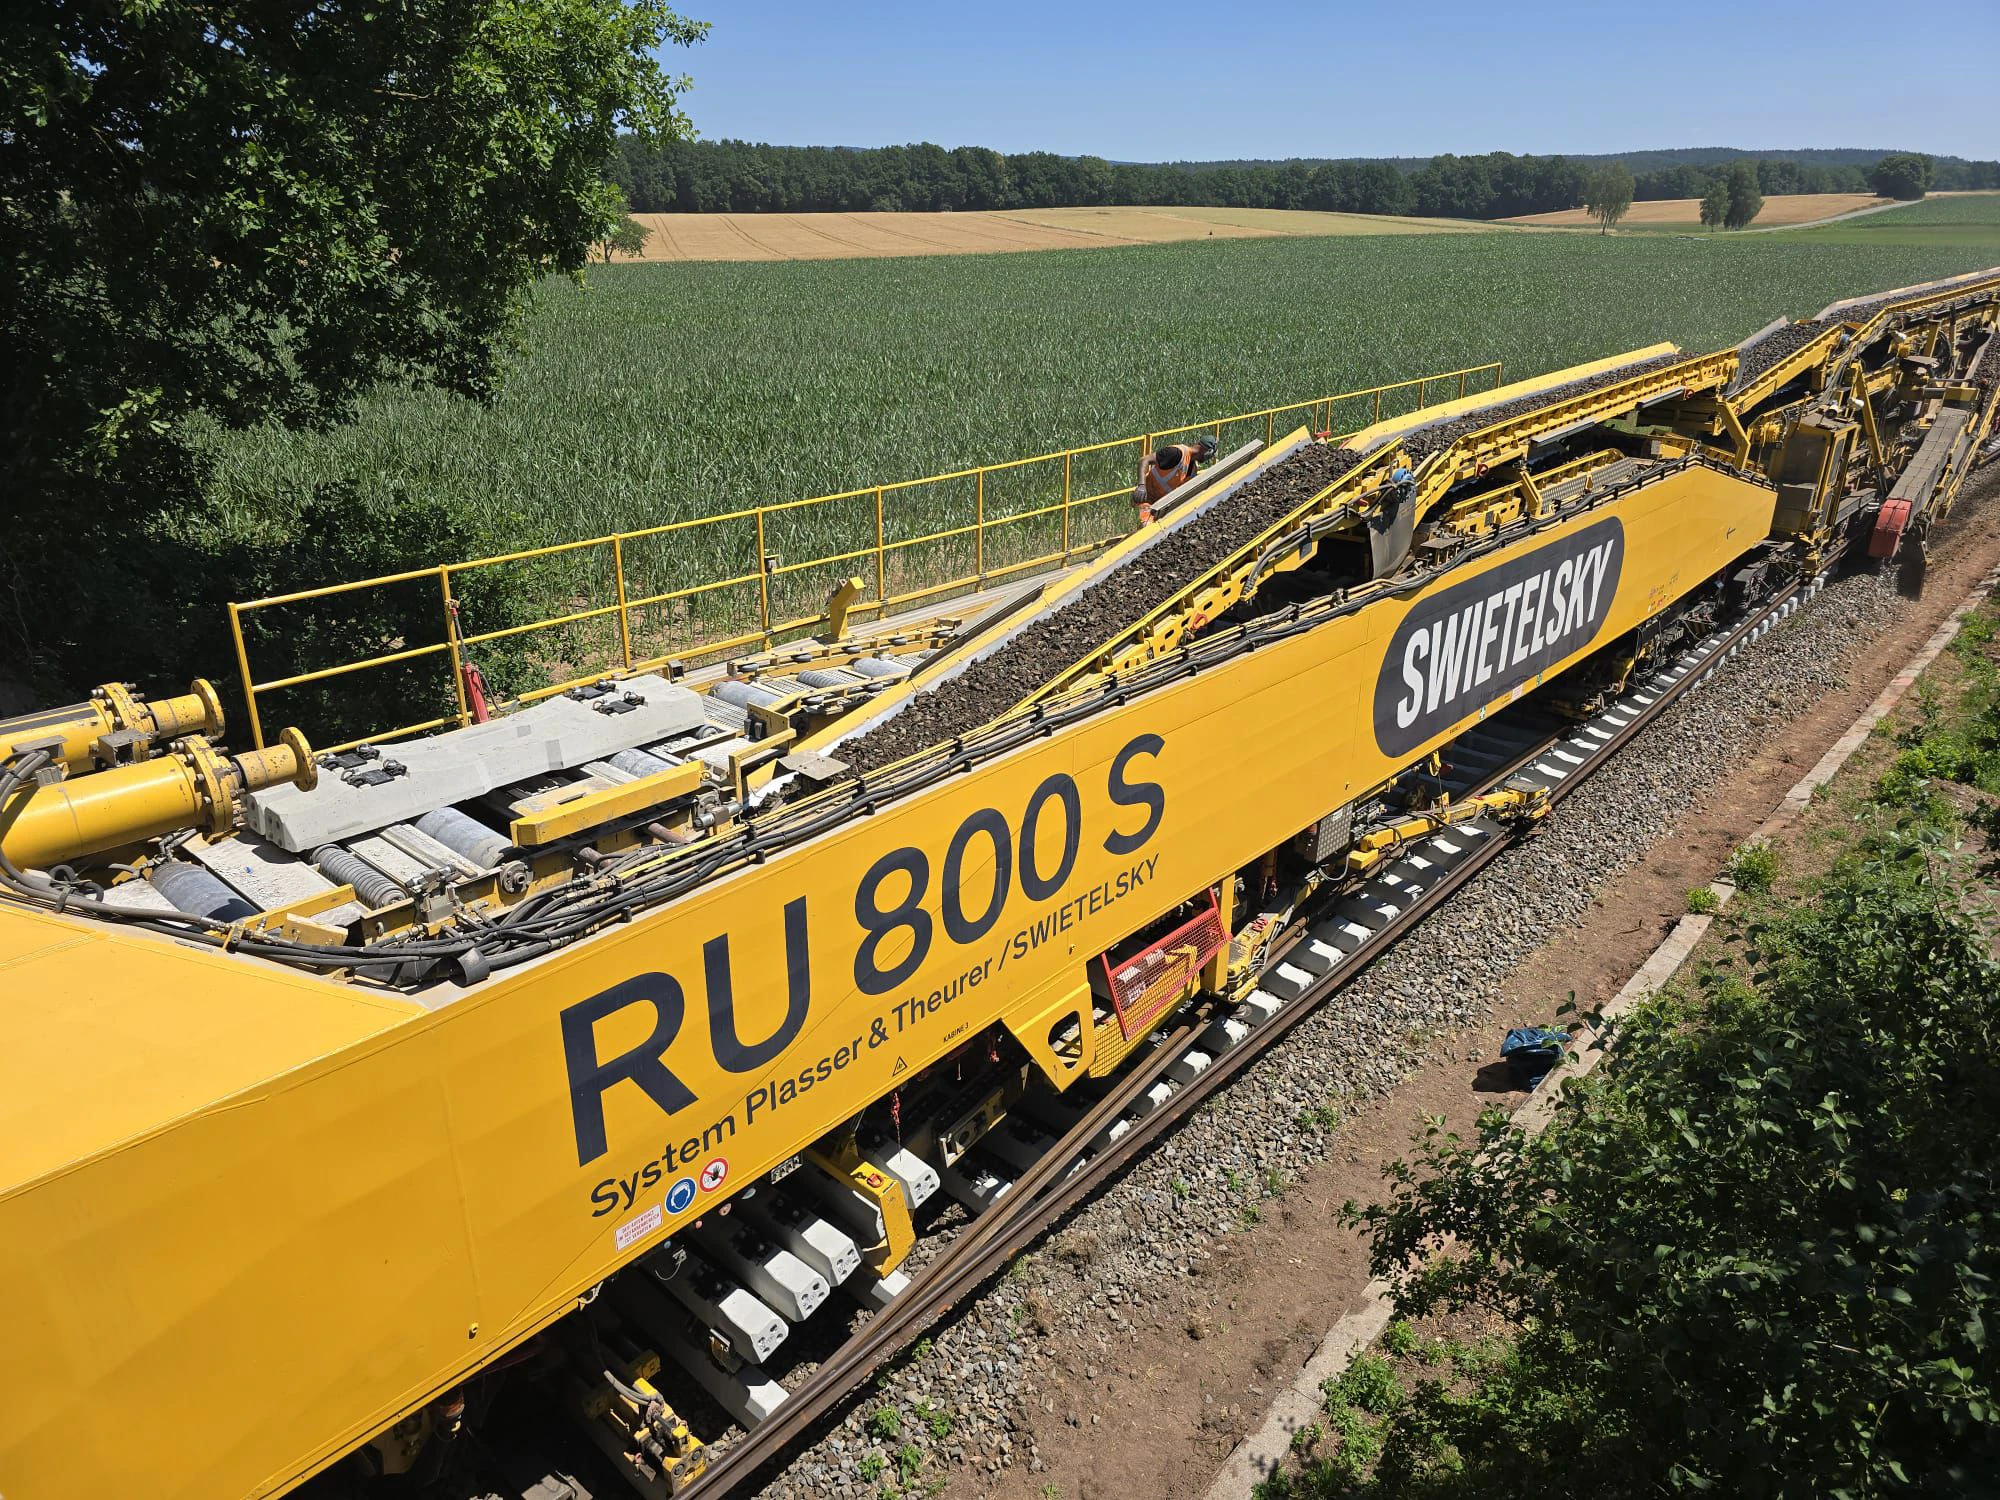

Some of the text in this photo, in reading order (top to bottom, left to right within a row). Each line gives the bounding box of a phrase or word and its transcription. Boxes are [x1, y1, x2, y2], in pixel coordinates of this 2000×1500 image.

[1396, 538, 1614, 729] SWIETELSKY
[560, 733, 1166, 1168] RU 800 S
[590, 1115, 736, 1218] System
[746, 1035, 863, 1126] Plasser
[868, 1017, 890, 1049] &
[891, 957, 993, 1032] Theurer
